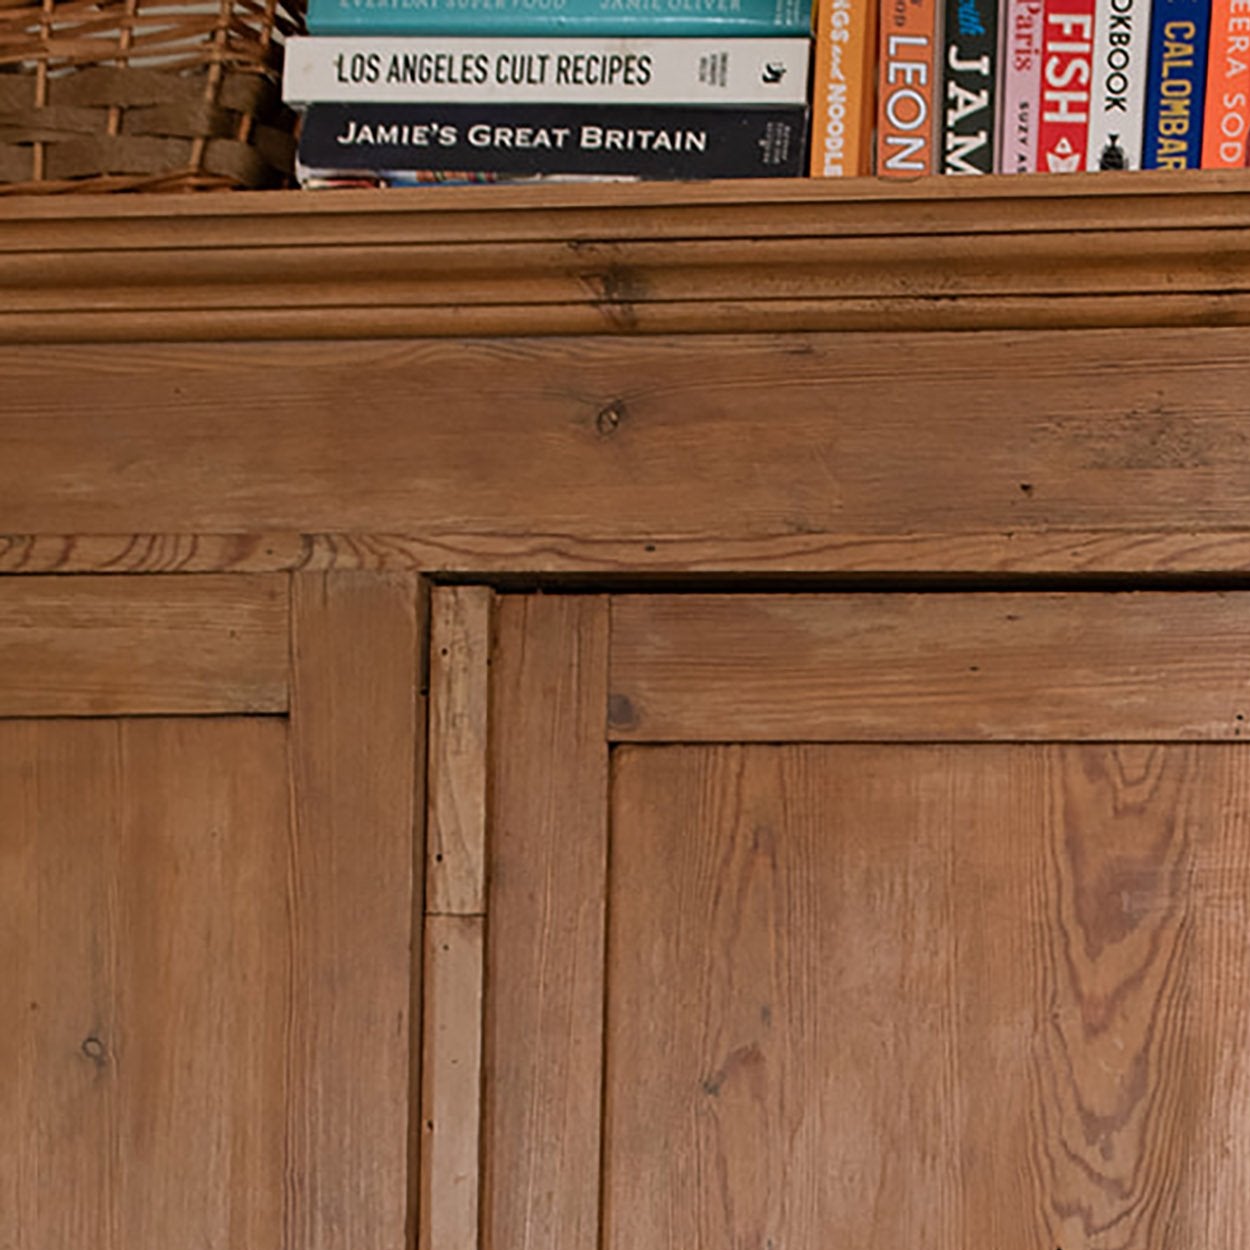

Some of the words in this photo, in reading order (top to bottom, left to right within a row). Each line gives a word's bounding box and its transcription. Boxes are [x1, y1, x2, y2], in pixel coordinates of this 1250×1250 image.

[337, 53, 380, 83] LOS
[386, 53, 489, 84] ANGELES
[495, 54, 550, 85] CULT
[556, 54, 653, 85] RECIPES
[1013, 0, 1041, 71] Paris
[1043, 14, 1093, 122] FISH
[336, 122, 459, 147] JAMIE'S
[467, 124, 570, 148] GREAT
[579, 125, 707, 151] BRITAIN
[886, 36, 929, 170] LEON
